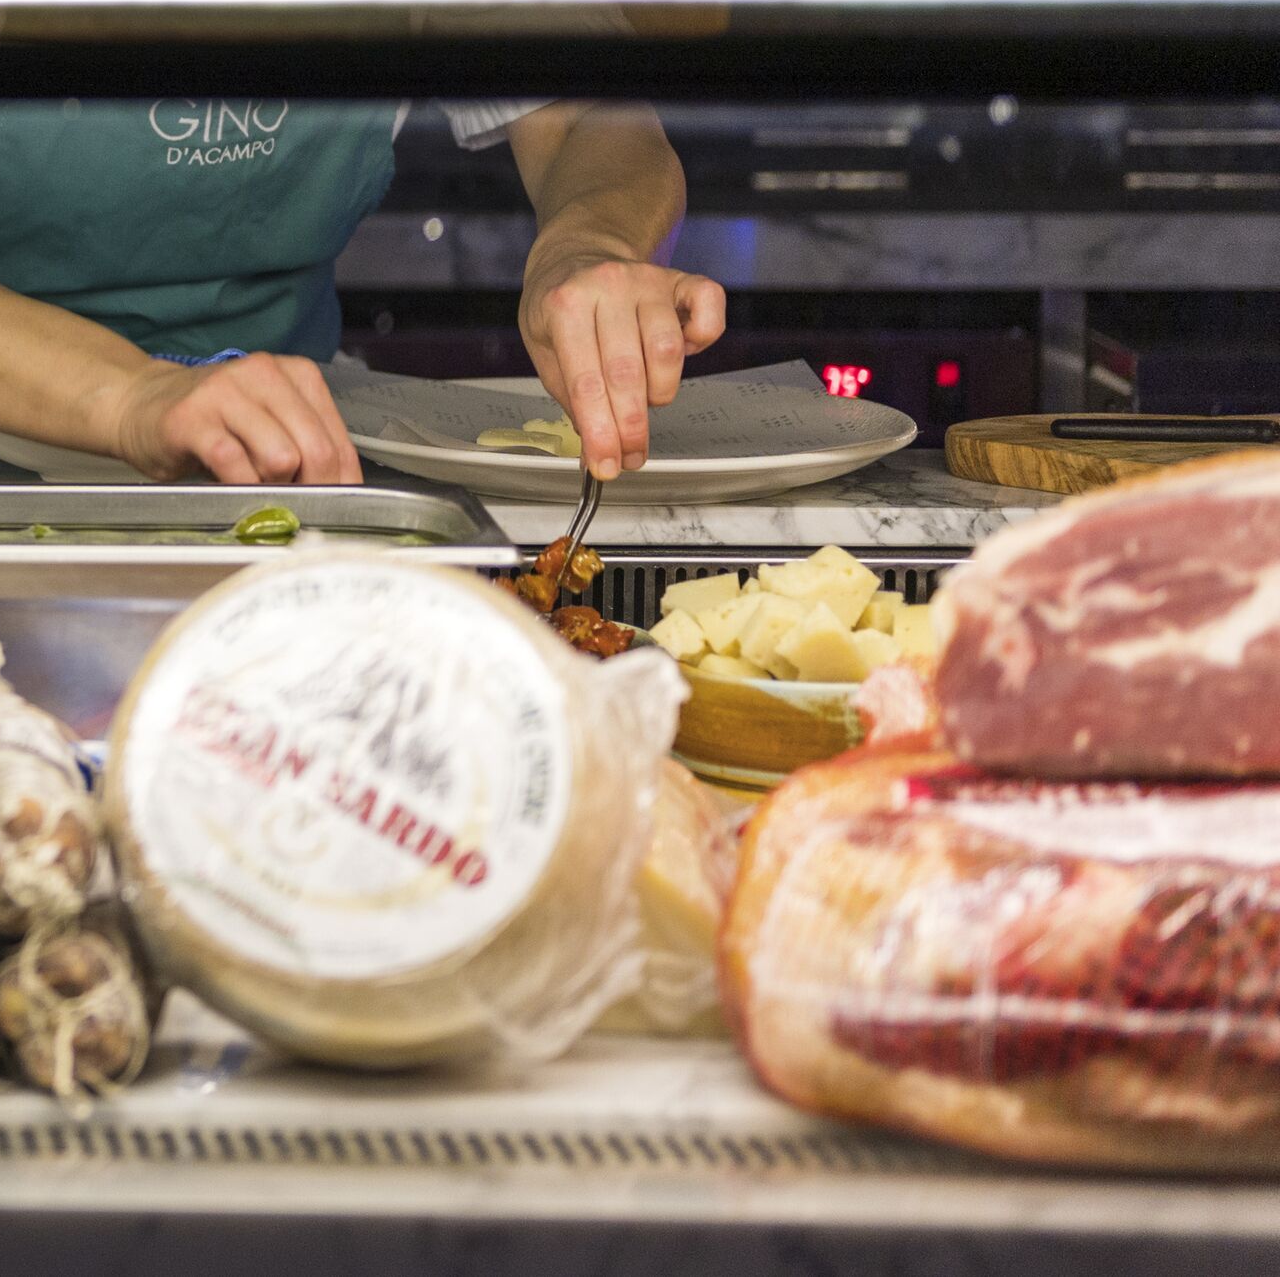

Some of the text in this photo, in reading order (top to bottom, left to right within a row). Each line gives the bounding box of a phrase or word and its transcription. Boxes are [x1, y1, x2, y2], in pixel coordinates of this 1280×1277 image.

[148, 99, 290, 144] GINO
[165, 137, 276, 166] D'ACAMPO
[322, 767, 490, 889] SARDO
